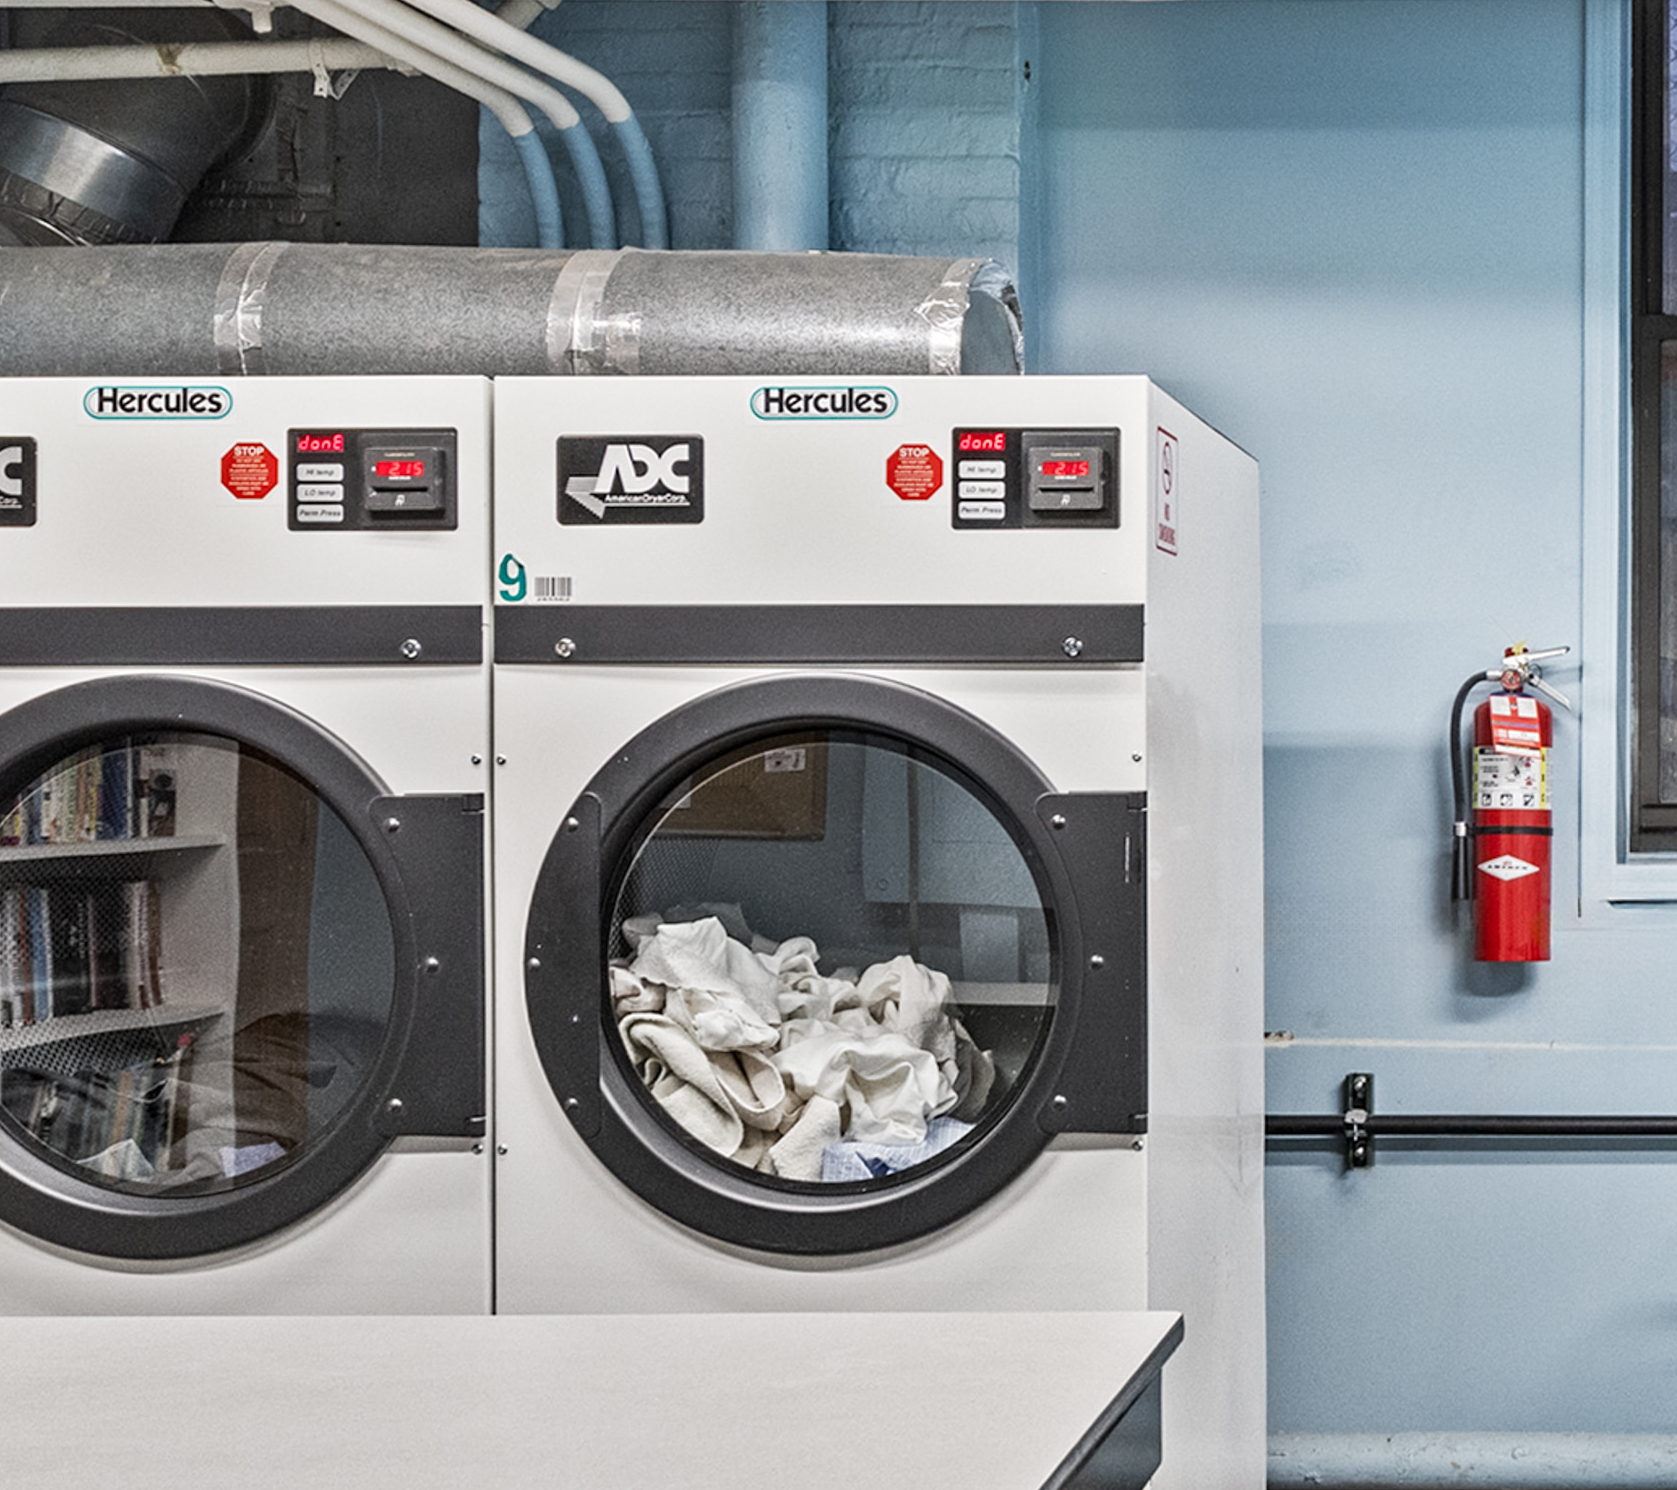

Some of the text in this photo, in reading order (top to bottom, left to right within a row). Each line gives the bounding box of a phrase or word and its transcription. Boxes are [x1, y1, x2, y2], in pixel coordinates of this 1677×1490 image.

[97, 387, 222, 414] Hercules
[763, 388, 888, 414] Hercules
[234, 446, 265, 456] STOP
[899, 448, 930, 458] STOP
[595, 445, 689, 492] ADC
[498, 553, 527, 602] 9
